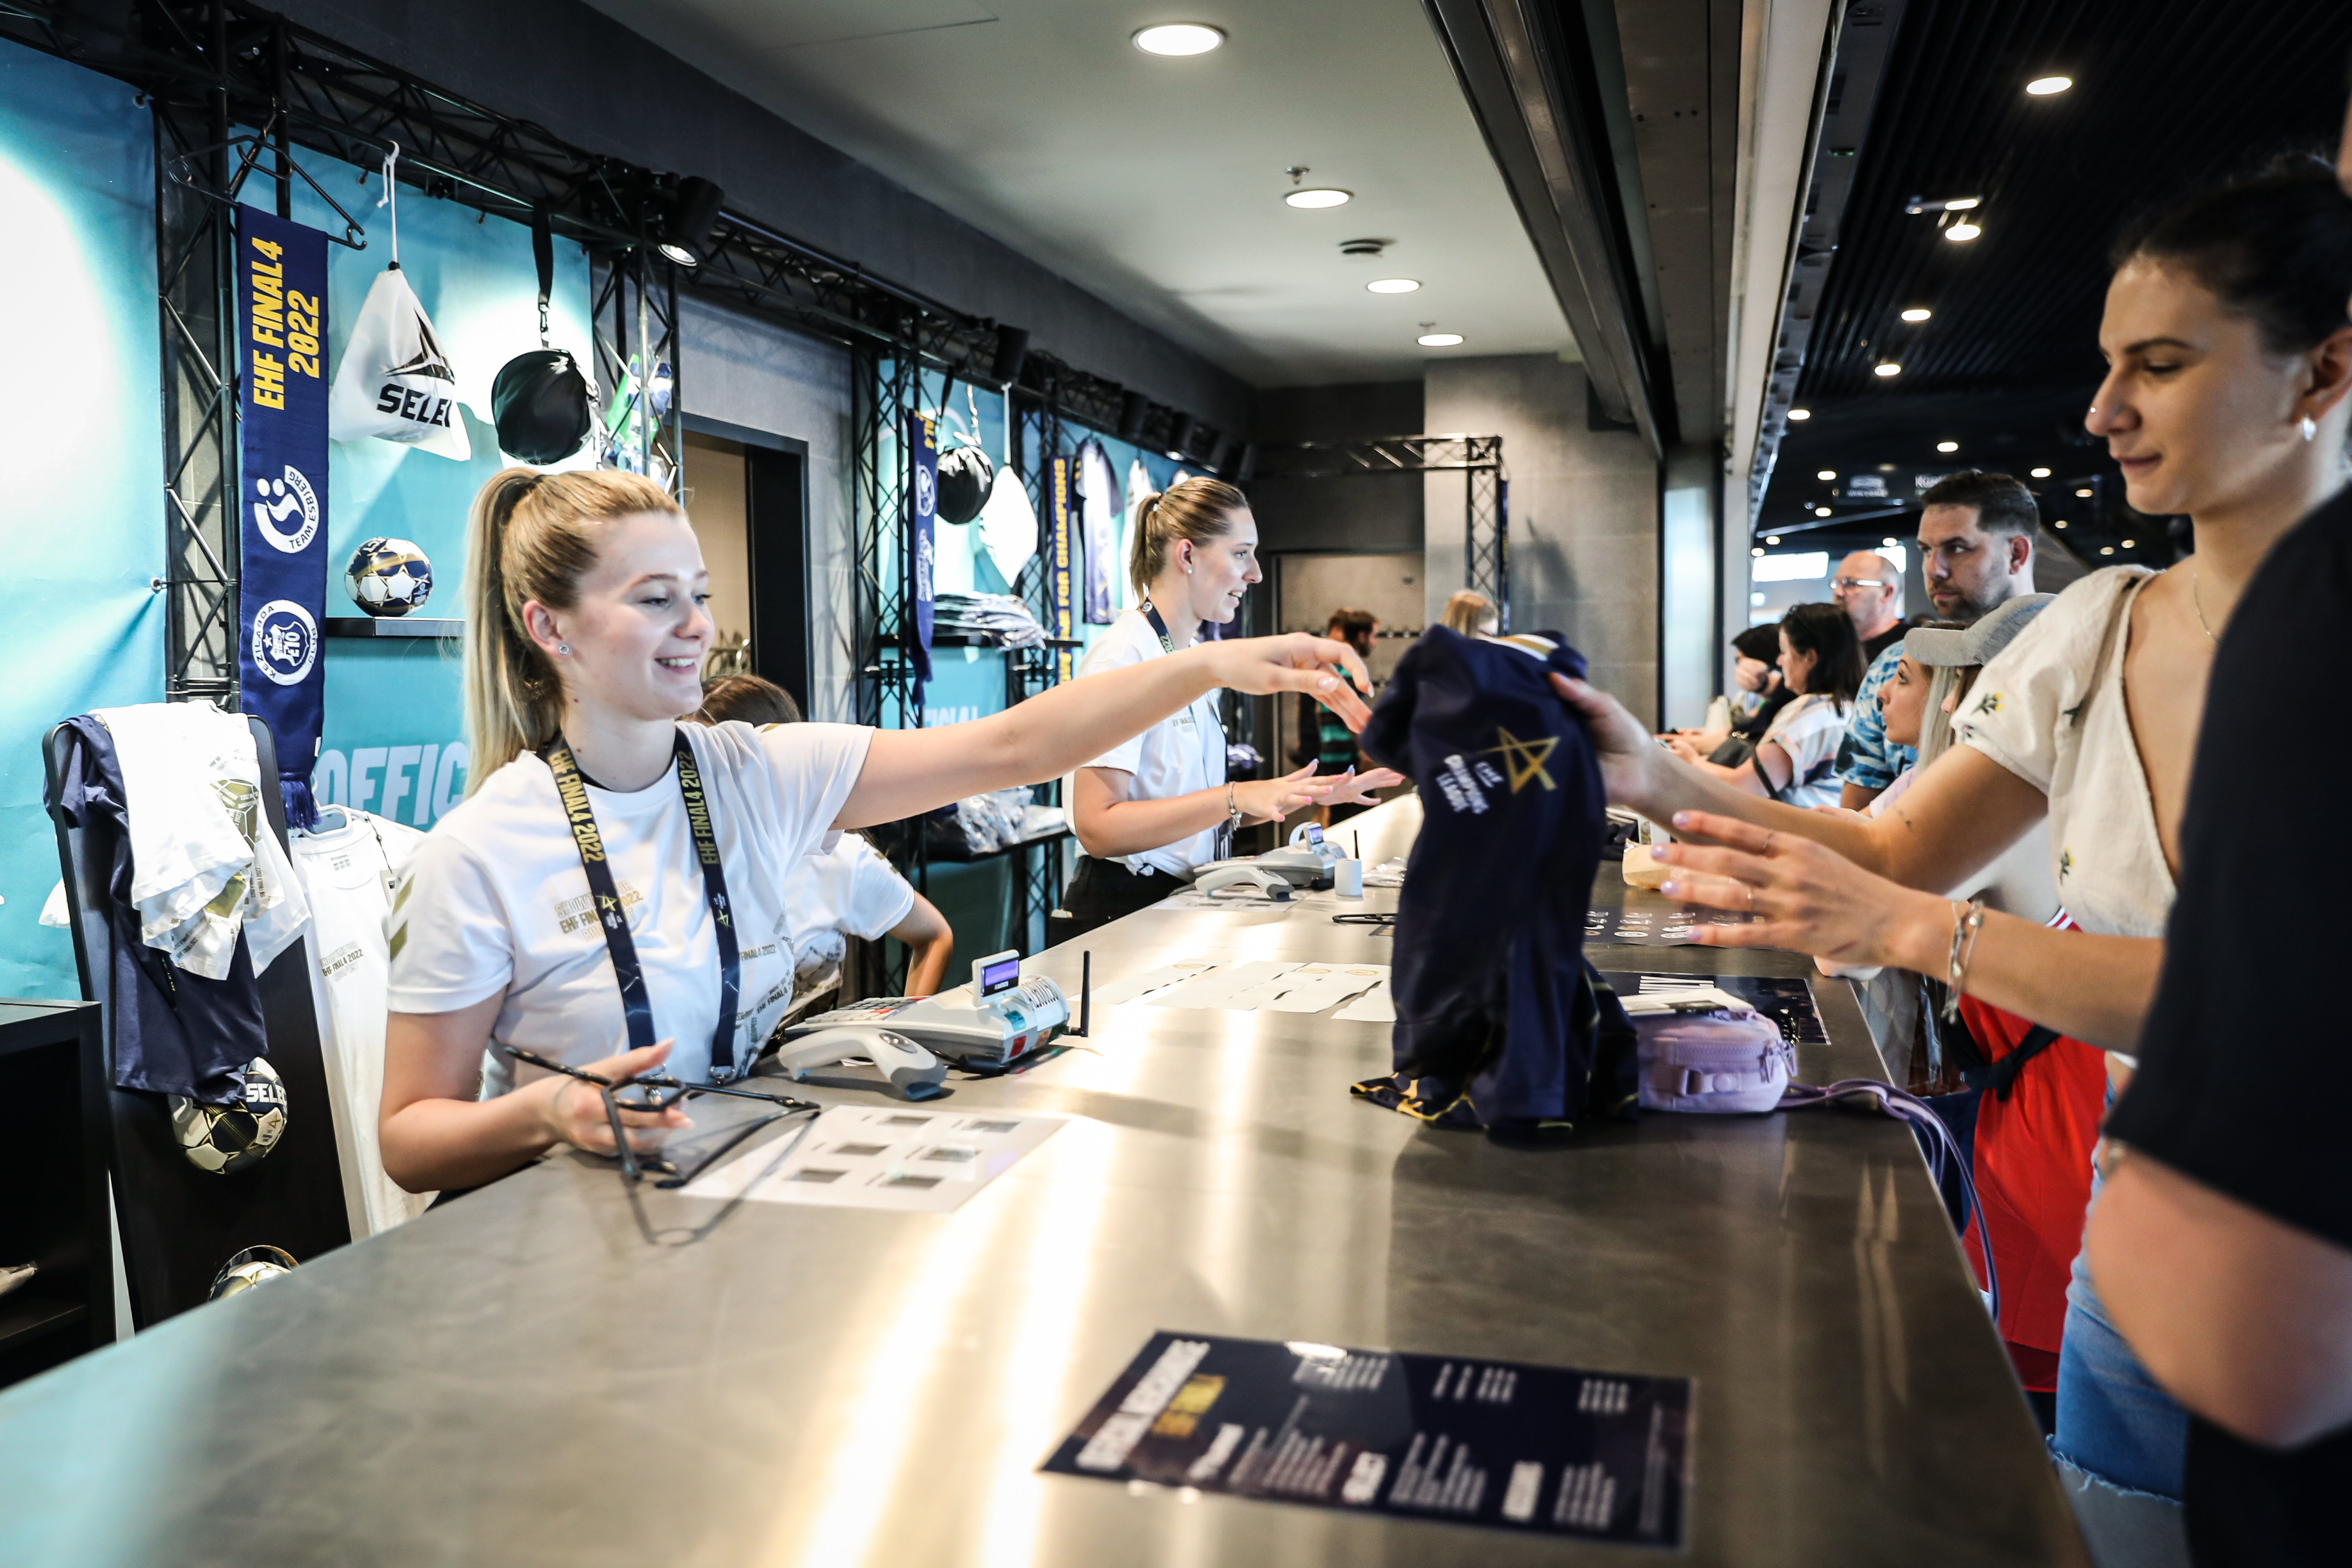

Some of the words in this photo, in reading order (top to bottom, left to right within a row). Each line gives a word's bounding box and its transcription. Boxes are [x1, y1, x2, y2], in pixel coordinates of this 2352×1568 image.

[252, 237, 283, 348] FINAL4
[287, 290, 320, 379] 2022
[253, 350, 285, 410] EHF
[289, 470, 316, 522] ESBJERG
[1054, 459, 1069, 568] CHAMPIONS
[289, 525, 314, 549] TEAM
[1057, 571, 1069, 607] FOR
[548, 748, 576, 774] EHF
[678, 750, 701, 788] 2022
[314, 742, 470, 833] OFFIC
[557, 773, 593, 822] FINAL4
[685, 791, 713, 838] FINAL4
[573, 823, 606, 863] 2022
[698, 840, 720, 864] EHF
[555, 892, 597, 918] SHOWT
[617, 880, 635, 893] OR
[559, 915, 579, 934] EHF
[579, 909, 600, 927] FIN
[620, 891, 643, 907] 022
[347, 948, 364, 962] 2022
[246, 1083, 287, 1106] SELEC
